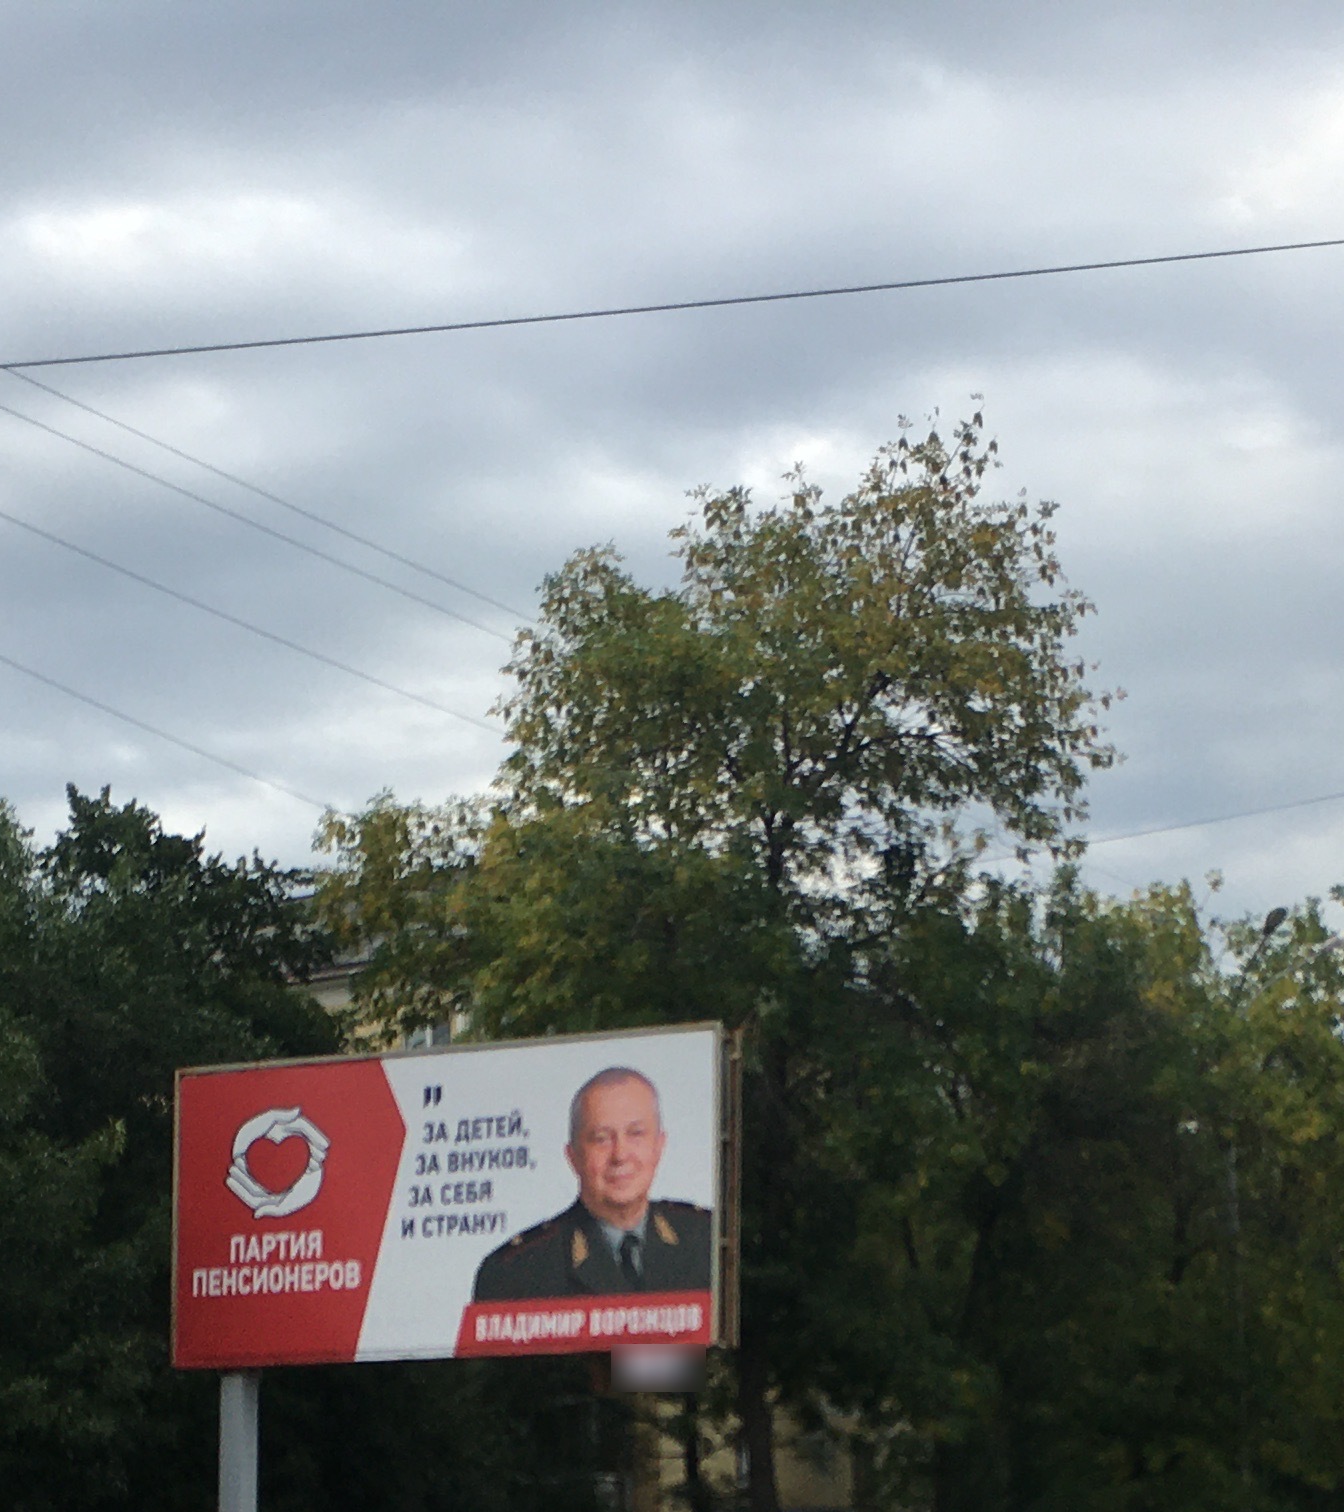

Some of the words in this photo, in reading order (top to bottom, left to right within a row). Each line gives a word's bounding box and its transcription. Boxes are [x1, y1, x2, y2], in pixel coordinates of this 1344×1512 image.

[423, 1120, 448, 1144] ЗА
[454, 1109, 530, 1146] ДЕТЕЙ,
[415, 1152, 440, 1176] ЗА
[447, 1146, 537, 1174] ВНУКОВ,
[408, 1184, 433, 1208] ЗА
[440, 1179, 493, 1206] СЕБЯ
[400, 1217, 415, 1240] И
[422, 1212, 507, 1239] СТРАНУ!
[230, 1230, 323, 1263] ПАРТИЯ
[192, 1260, 362, 1297] ПЕНСИОНЕРОВ
[475, 1309, 585, 1344] ВЛАДИМИР
